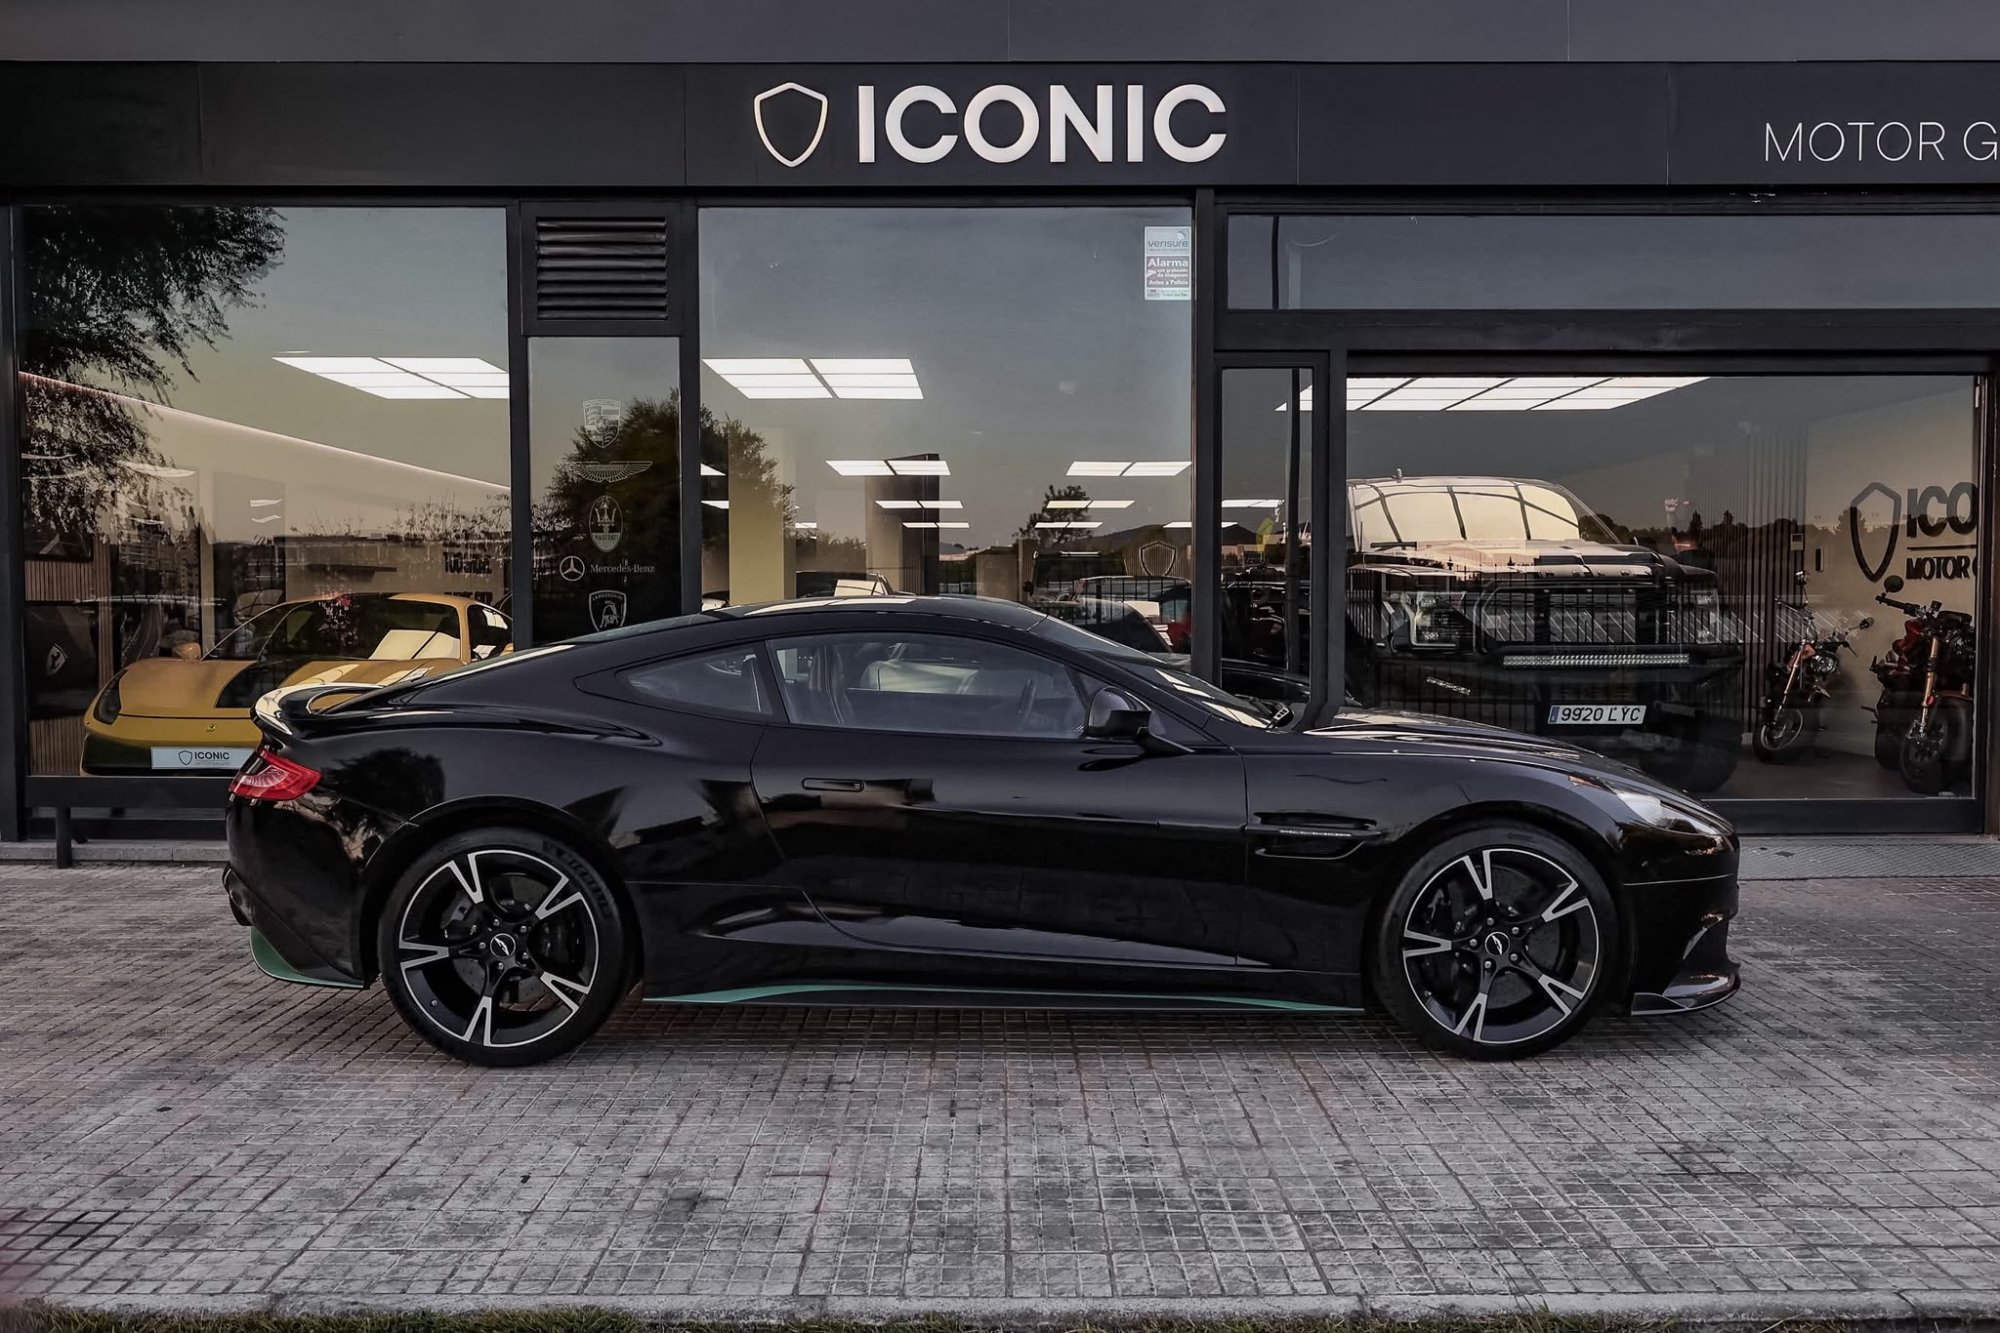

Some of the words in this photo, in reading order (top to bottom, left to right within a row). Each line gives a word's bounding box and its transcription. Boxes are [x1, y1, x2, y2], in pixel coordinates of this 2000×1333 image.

[858, 84, 1227, 163] ICONIC
[1765, 121, 1945, 161] MOTOR
[1963, 121, 1999, 161] G
[1148, 240, 1189, 248] verisure
[1148, 257, 1189, 267] Alarma
[591, 564, 655, 573] Mercedes-Benz
[1906, 555, 1970, 580] MOTOR
[1561, 707, 1604, 721] 9920
[1608, 707, 1641, 722] LYC
[194, 751, 230, 760] ICONIC
